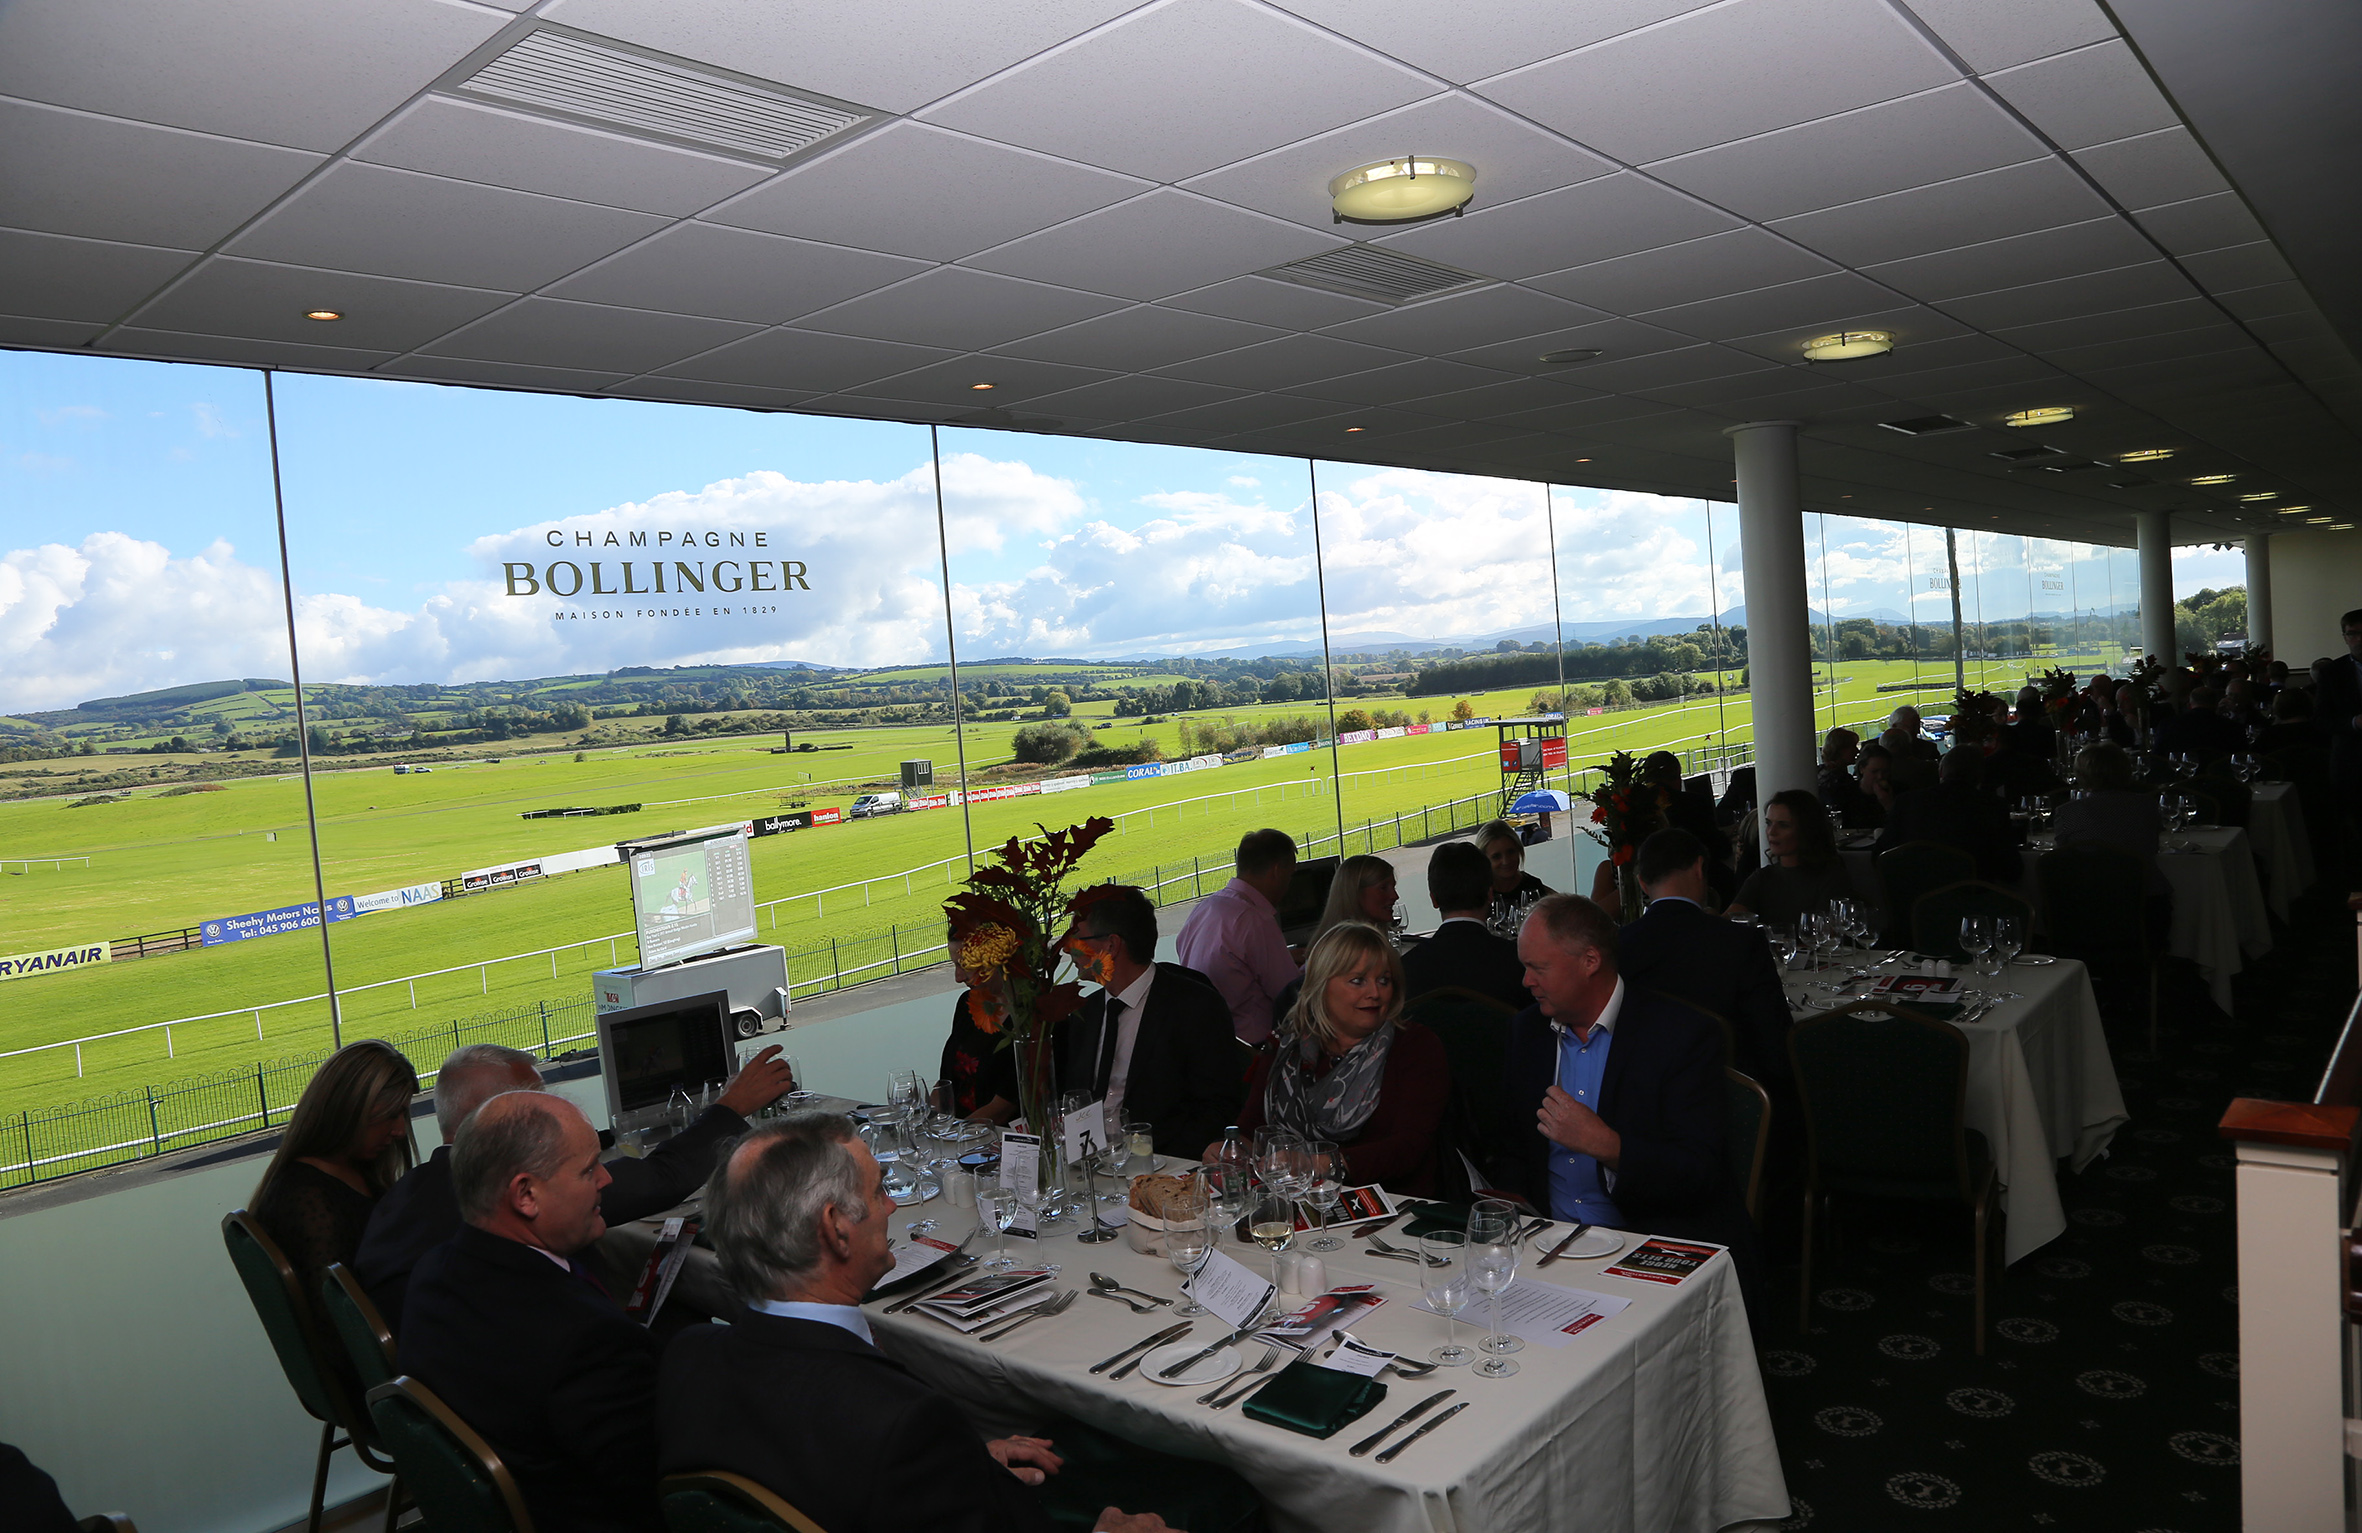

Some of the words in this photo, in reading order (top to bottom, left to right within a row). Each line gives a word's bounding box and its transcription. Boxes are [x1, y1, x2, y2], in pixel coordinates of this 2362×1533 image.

[546, 530, 768, 547] CHAMPAGNE
[502, 560, 812, 597] BOLLINGER
[2042, 580, 2064, 591] BOLLINGER
[555, 610, 624, 621] MAISON
[637, 606, 701, 618] FONDÉE
[714, 607, 731, 616] EN
[743, 606, 777, 615] 1829
[1344, 730, 1372, 744] BETDAQ
[1128, 766, 1153, 778] CORAL
[813, 812, 839, 822] hanlon
[356, 897, 390, 910] Welcome
[391, 895, 399, 904] to
[401, 884, 439, 905] NAAS
[226, 914, 264, 931] Sheehy
[266, 909, 301, 924] Motors
[240, 927, 258, 939] Tel:
[260, 924, 278, 936] 045
[280, 921, 299, 933] 906
[300, 916, 321, 928] 600
[0, 947, 102, 977] RYANAIR
[1079, 1129, 1091, 1154] 7
[1632, 1252, 1662, 1261] BETS
[1664, 1256, 1698, 1267] YOUR
[1639, 1260, 1679, 1269] HEDGE
